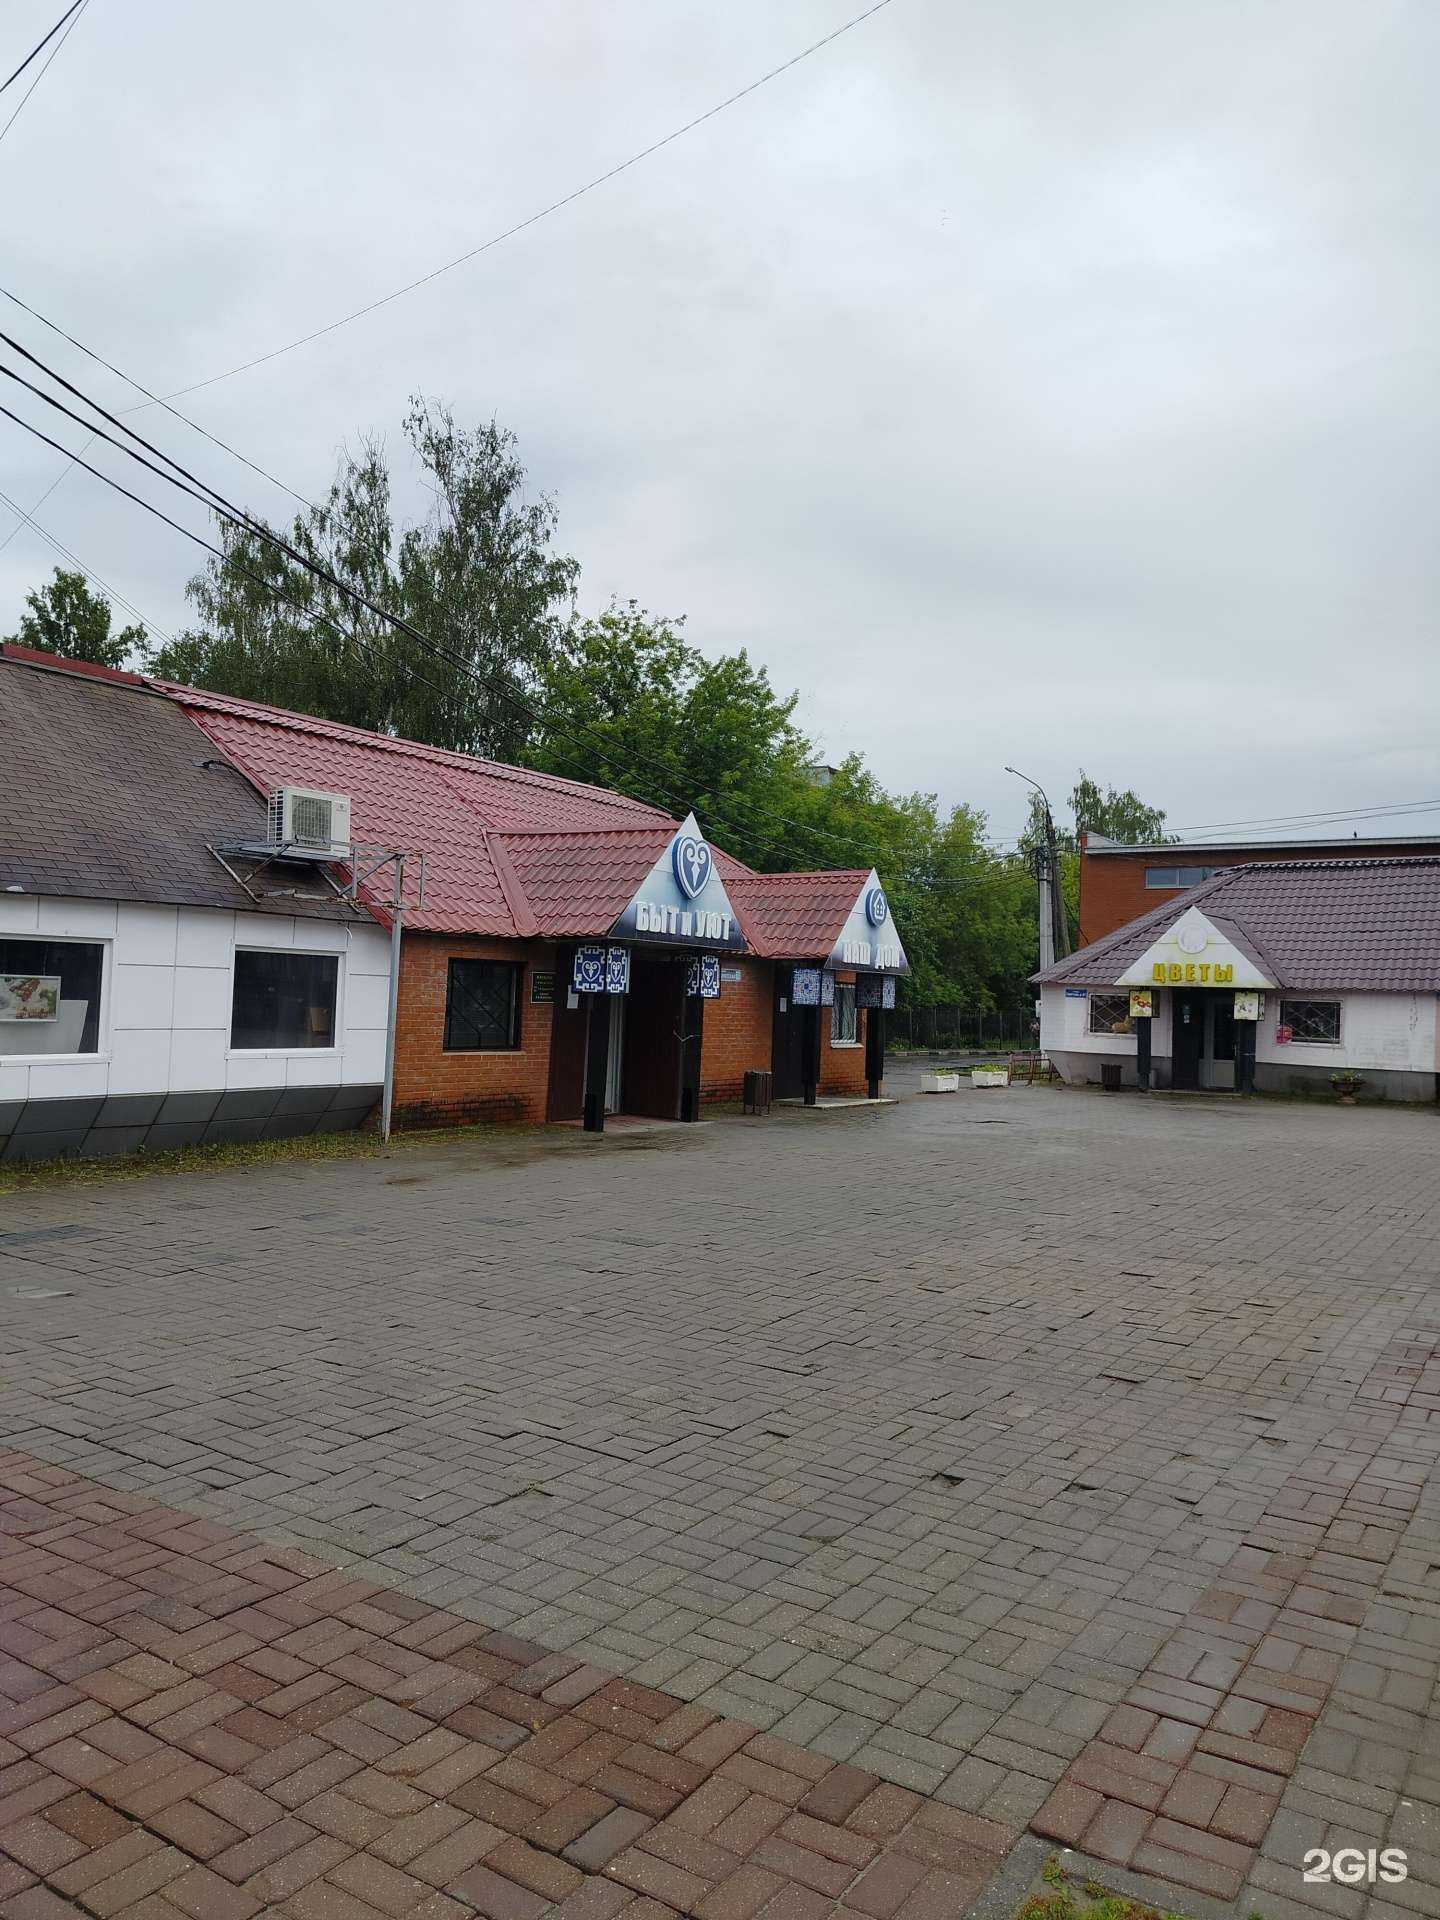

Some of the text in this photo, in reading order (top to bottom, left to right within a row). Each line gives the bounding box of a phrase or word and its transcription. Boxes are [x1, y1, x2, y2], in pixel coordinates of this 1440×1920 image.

[635, 901, 679, 934] БЫТ
[695, 909, 731, 940] УЮТ
[842, 940, 900, 970] НАШ ДОМ
[1152, 962, 1233, 984] ЦВЕТЫ
